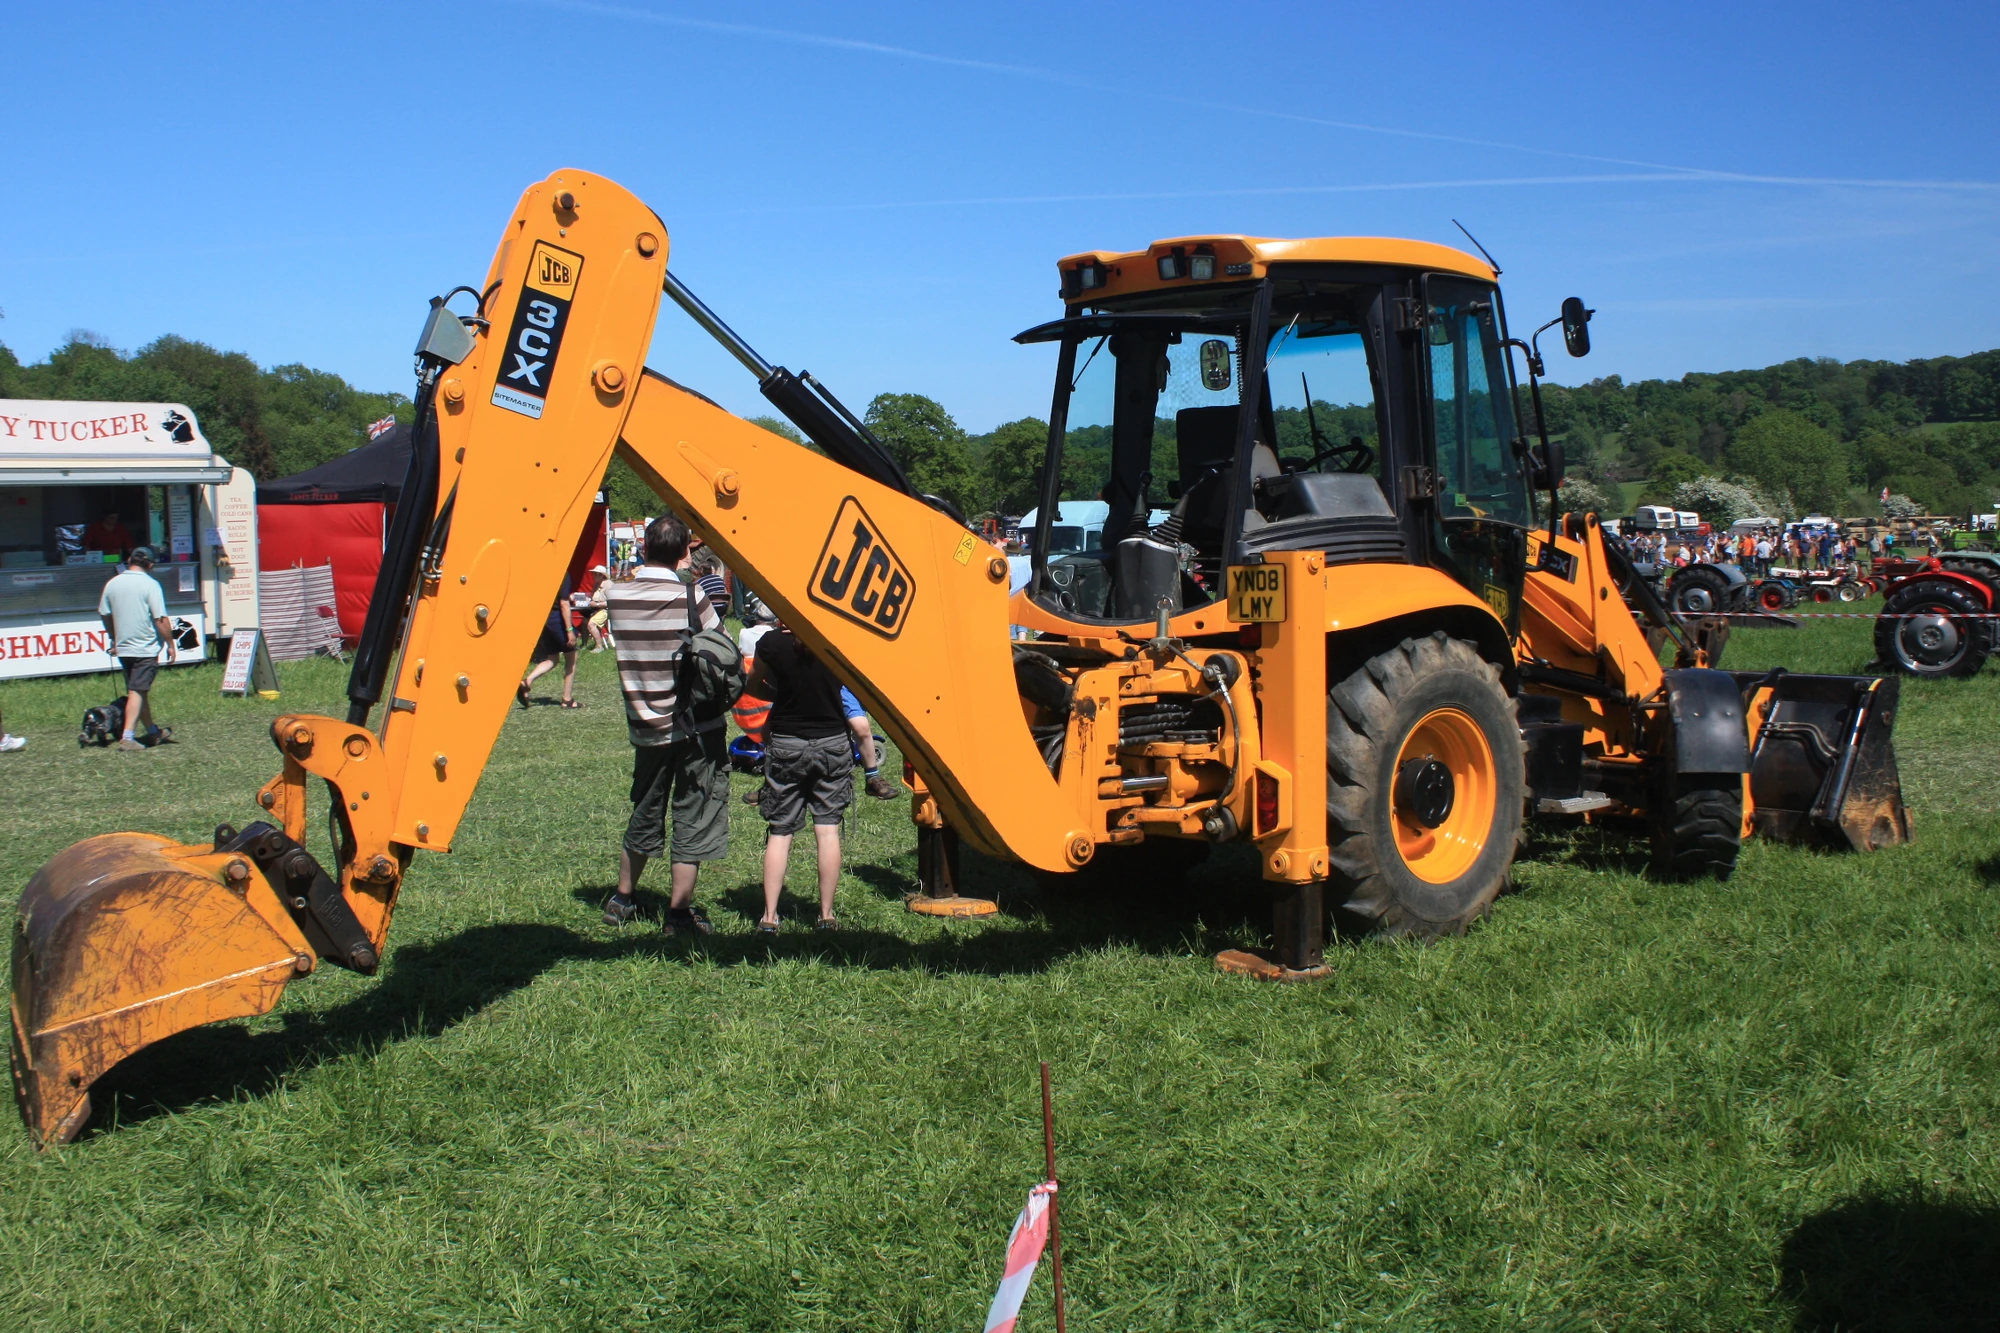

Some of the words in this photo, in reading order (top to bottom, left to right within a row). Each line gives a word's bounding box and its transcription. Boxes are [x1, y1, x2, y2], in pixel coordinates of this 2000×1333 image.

[542, 256, 570, 284] JCB
[507, 300, 558, 387] 3CX
[495, 392, 542, 412] SITEMASTER
[29, 413, 149, 441] TUCKER
[820, 518, 908, 629] JCB
[1233, 569, 1279, 592] YN08
[1239, 596, 1273, 618] LMY
[236, 641, 251, 649] CHIPS
[223, 680, 234, 688] COLD
